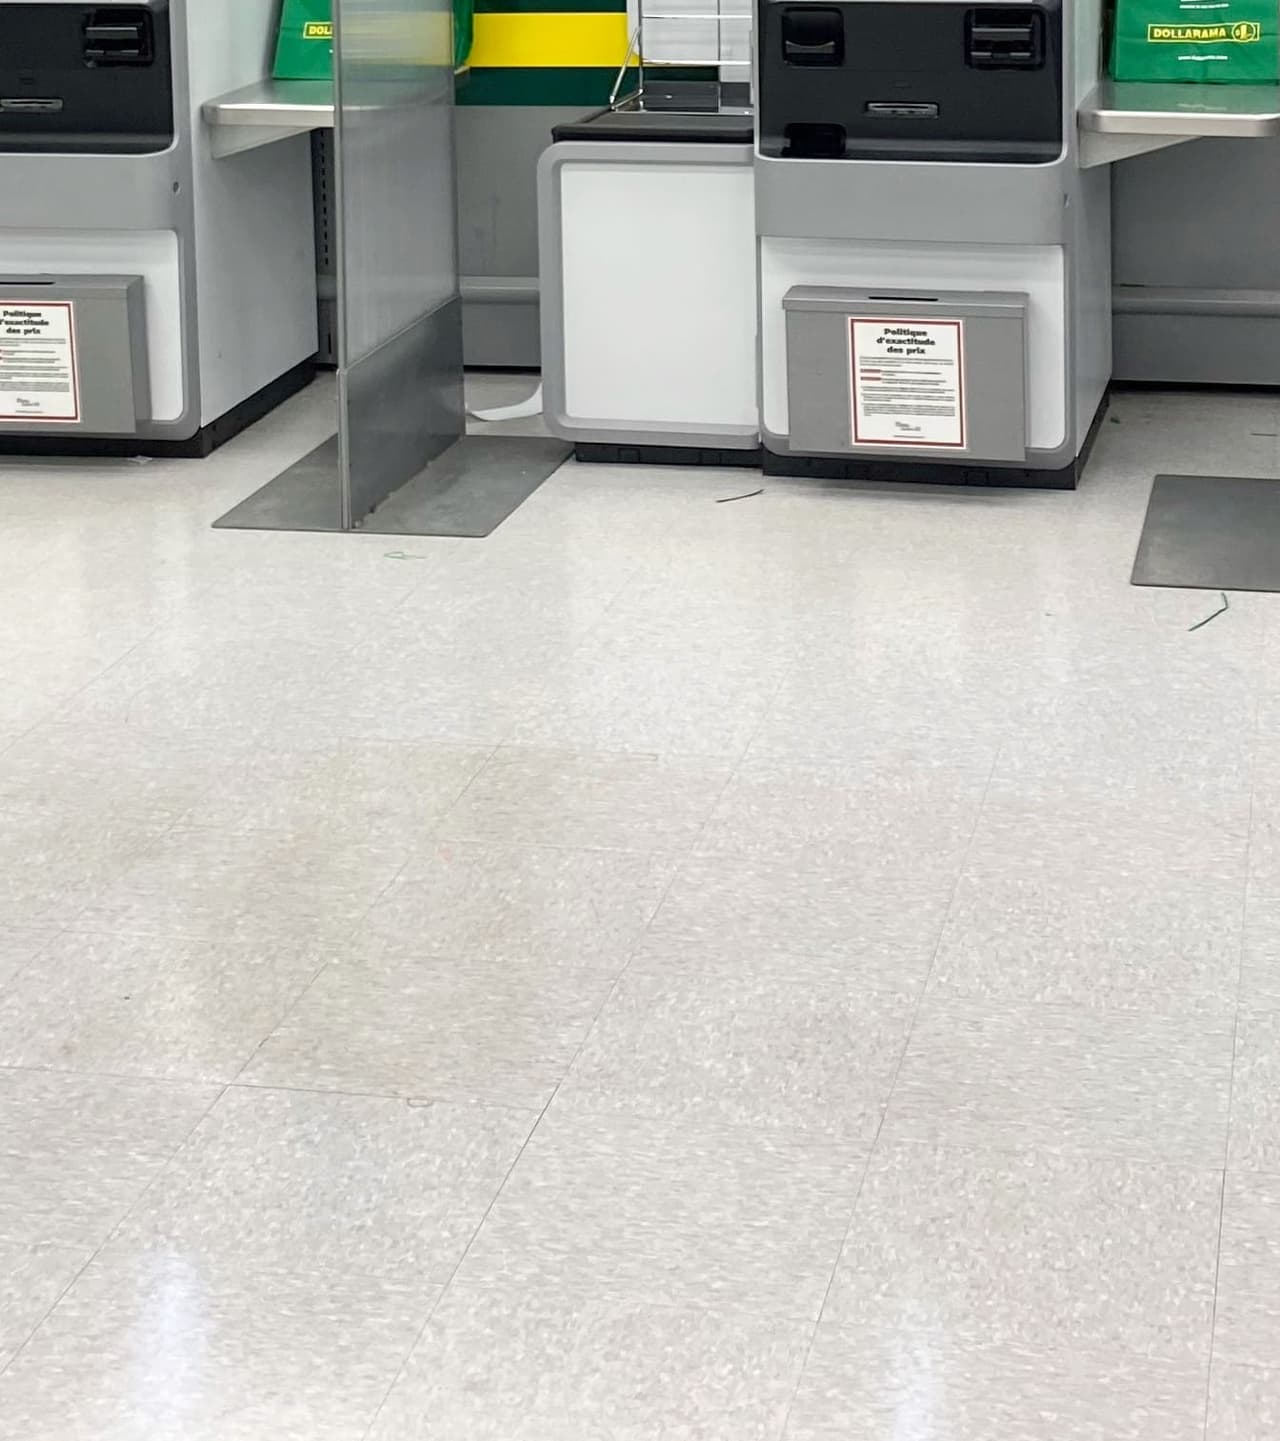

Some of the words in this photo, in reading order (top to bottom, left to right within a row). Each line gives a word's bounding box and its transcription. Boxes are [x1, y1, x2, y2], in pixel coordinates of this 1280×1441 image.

[1154, 28, 1226, 38] DOLLARAMA
[3, 311, 41, 319] Politique
[884, 328, 927, 337] Politique
[876, 338, 935, 346] d'exactitude
